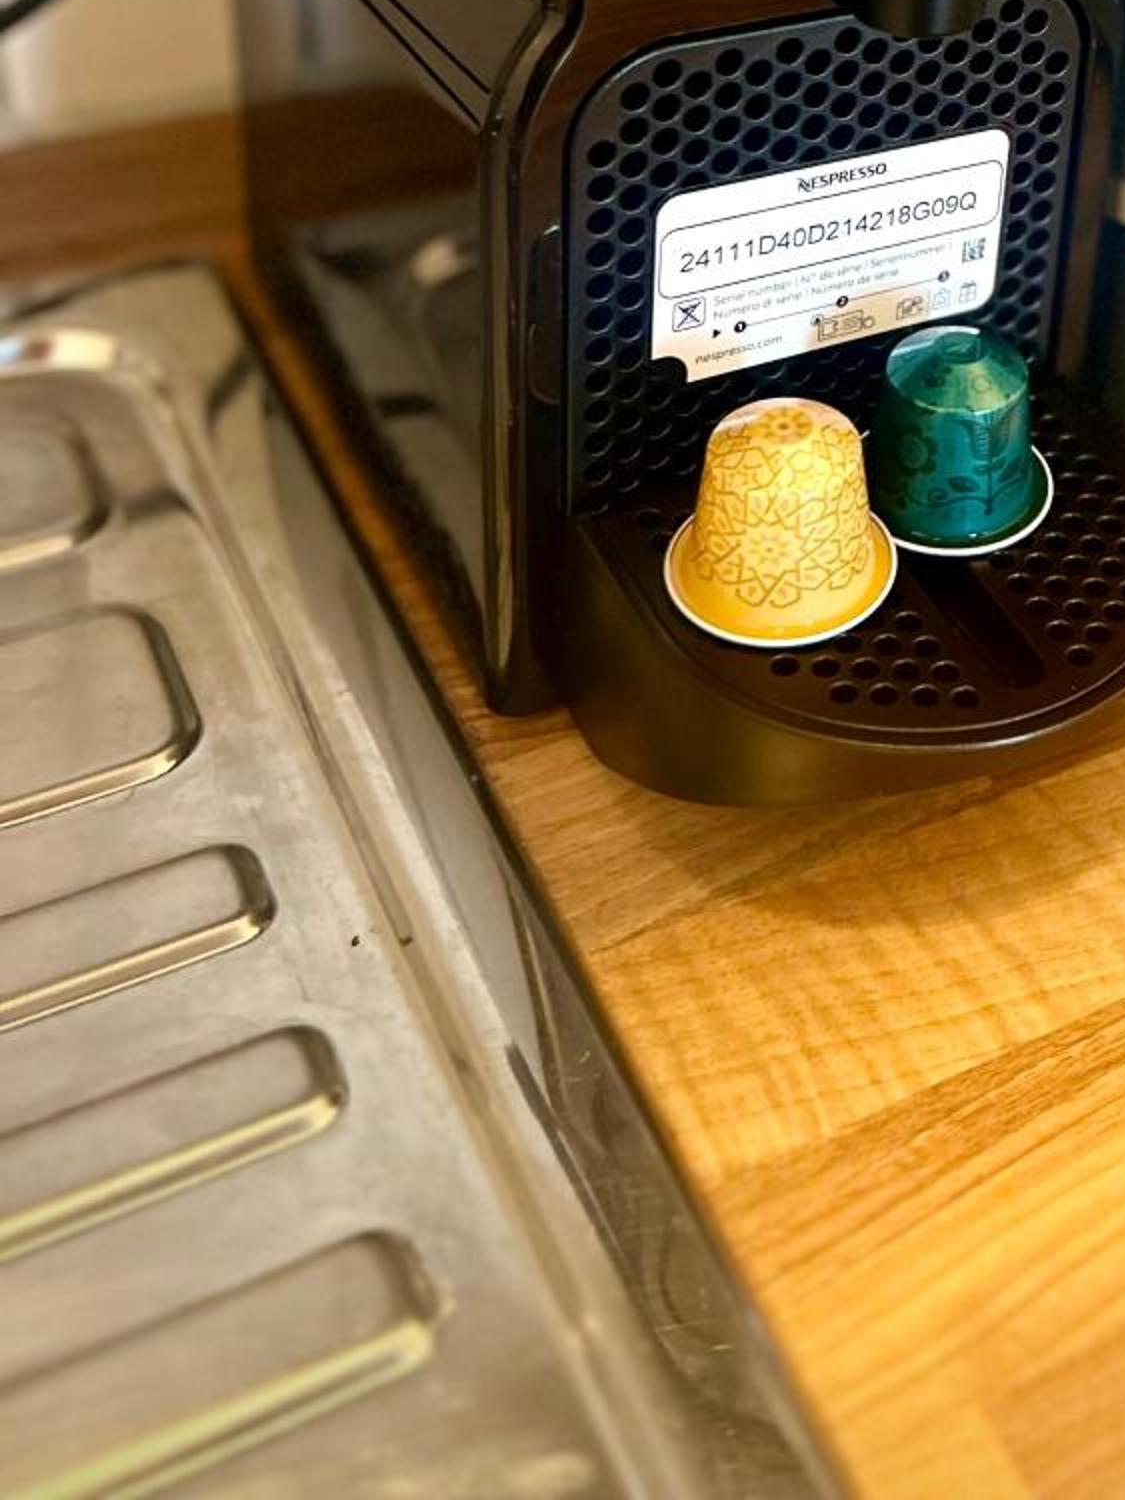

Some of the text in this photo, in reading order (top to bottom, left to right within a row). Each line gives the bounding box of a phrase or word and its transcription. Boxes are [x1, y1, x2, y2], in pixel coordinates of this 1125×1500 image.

[797, 163, 887, 193] NESPRESSO
[680, 191, 977, 273] 24111D40D214218G09Q
[695, 335, 783, 364] nespresso.com
